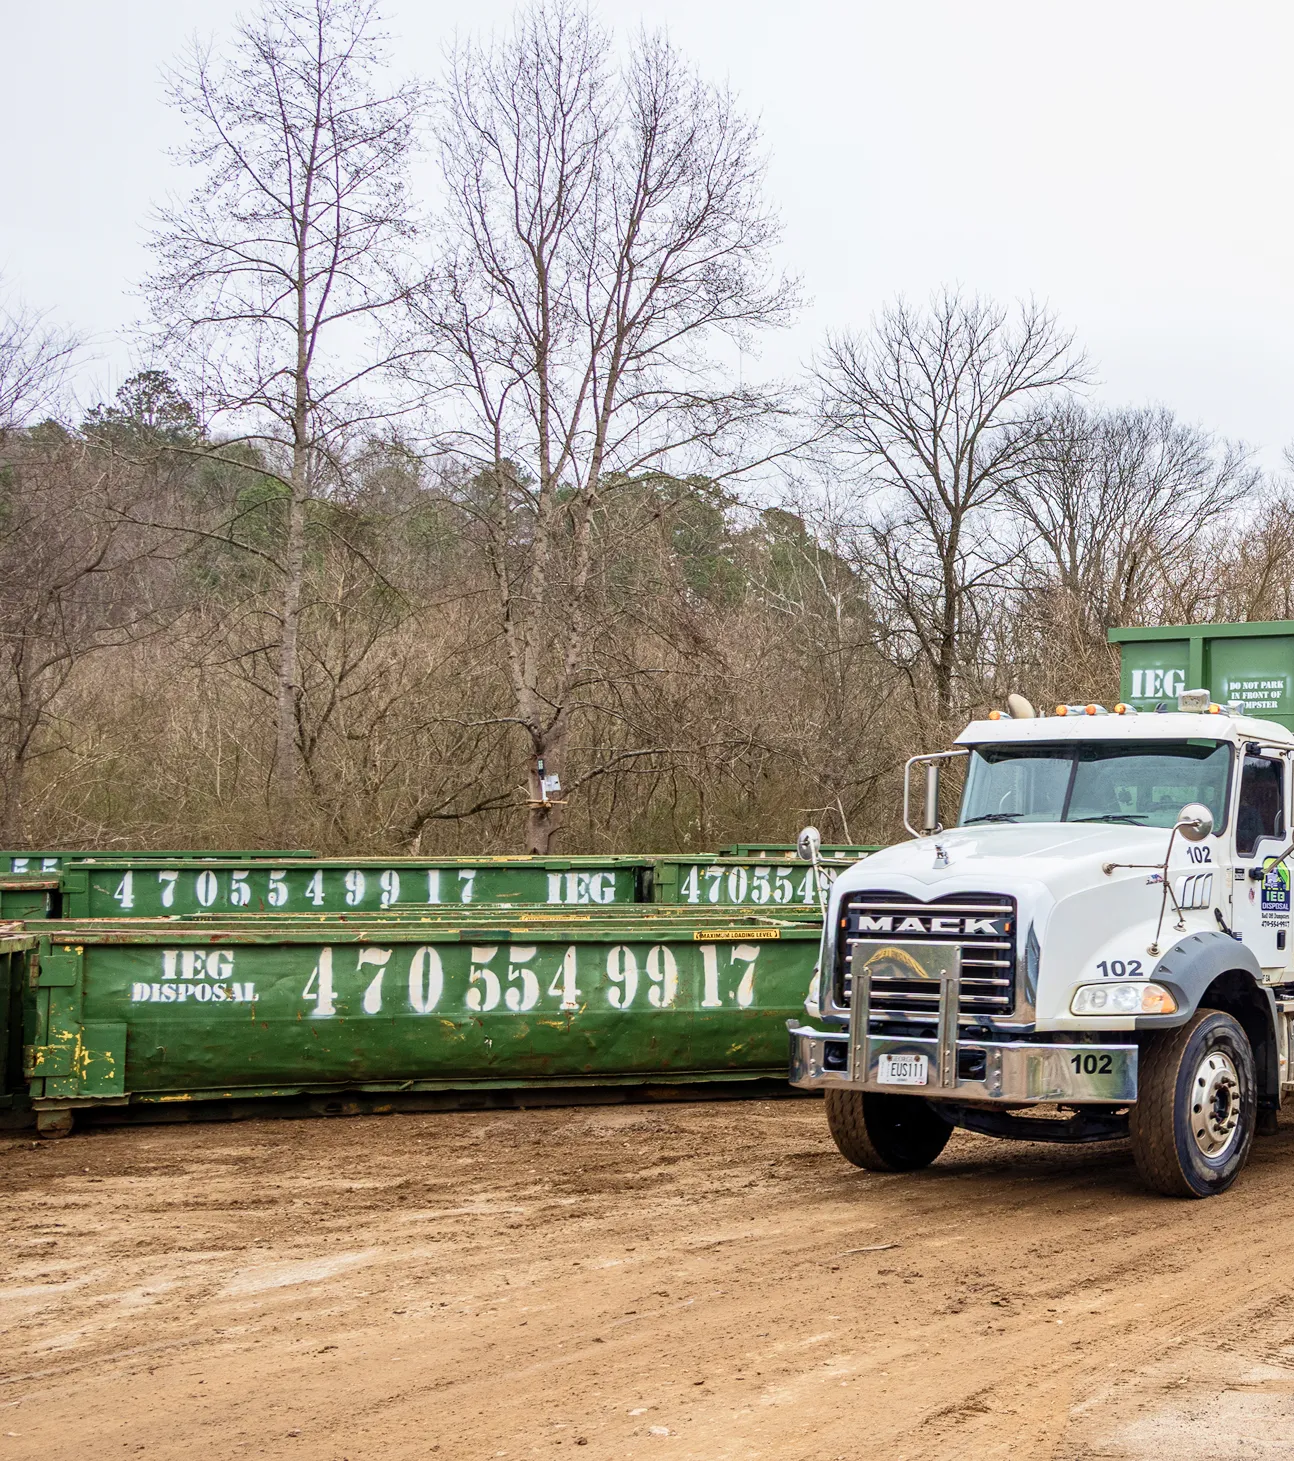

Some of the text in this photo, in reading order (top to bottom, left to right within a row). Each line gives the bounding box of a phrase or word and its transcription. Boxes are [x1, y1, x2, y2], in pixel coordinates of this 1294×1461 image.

[1131, 669, 1186, 699] IEG
[1229, 680, 1284, 690] DO NOT PARK
[1231, 690, 1282, 700] IN FRONT OF
[1244, 701, 1278, 709] MPSTER
[1187, 845, 1213, 864] 102
[547, 872, 616, 904] IEG
[1262, 902, 1289, 910] DISPOSAL
[858, 916, 999, 935] MACK
[161, 949, 235, 980] IEG
[1096, 959, 1144, 978] 102
[132, 982, 259, 1002] DISPOSAL
[890, 1062, 923, 1077] EUS111
[1071, 1053, 1113, 1075] 102
